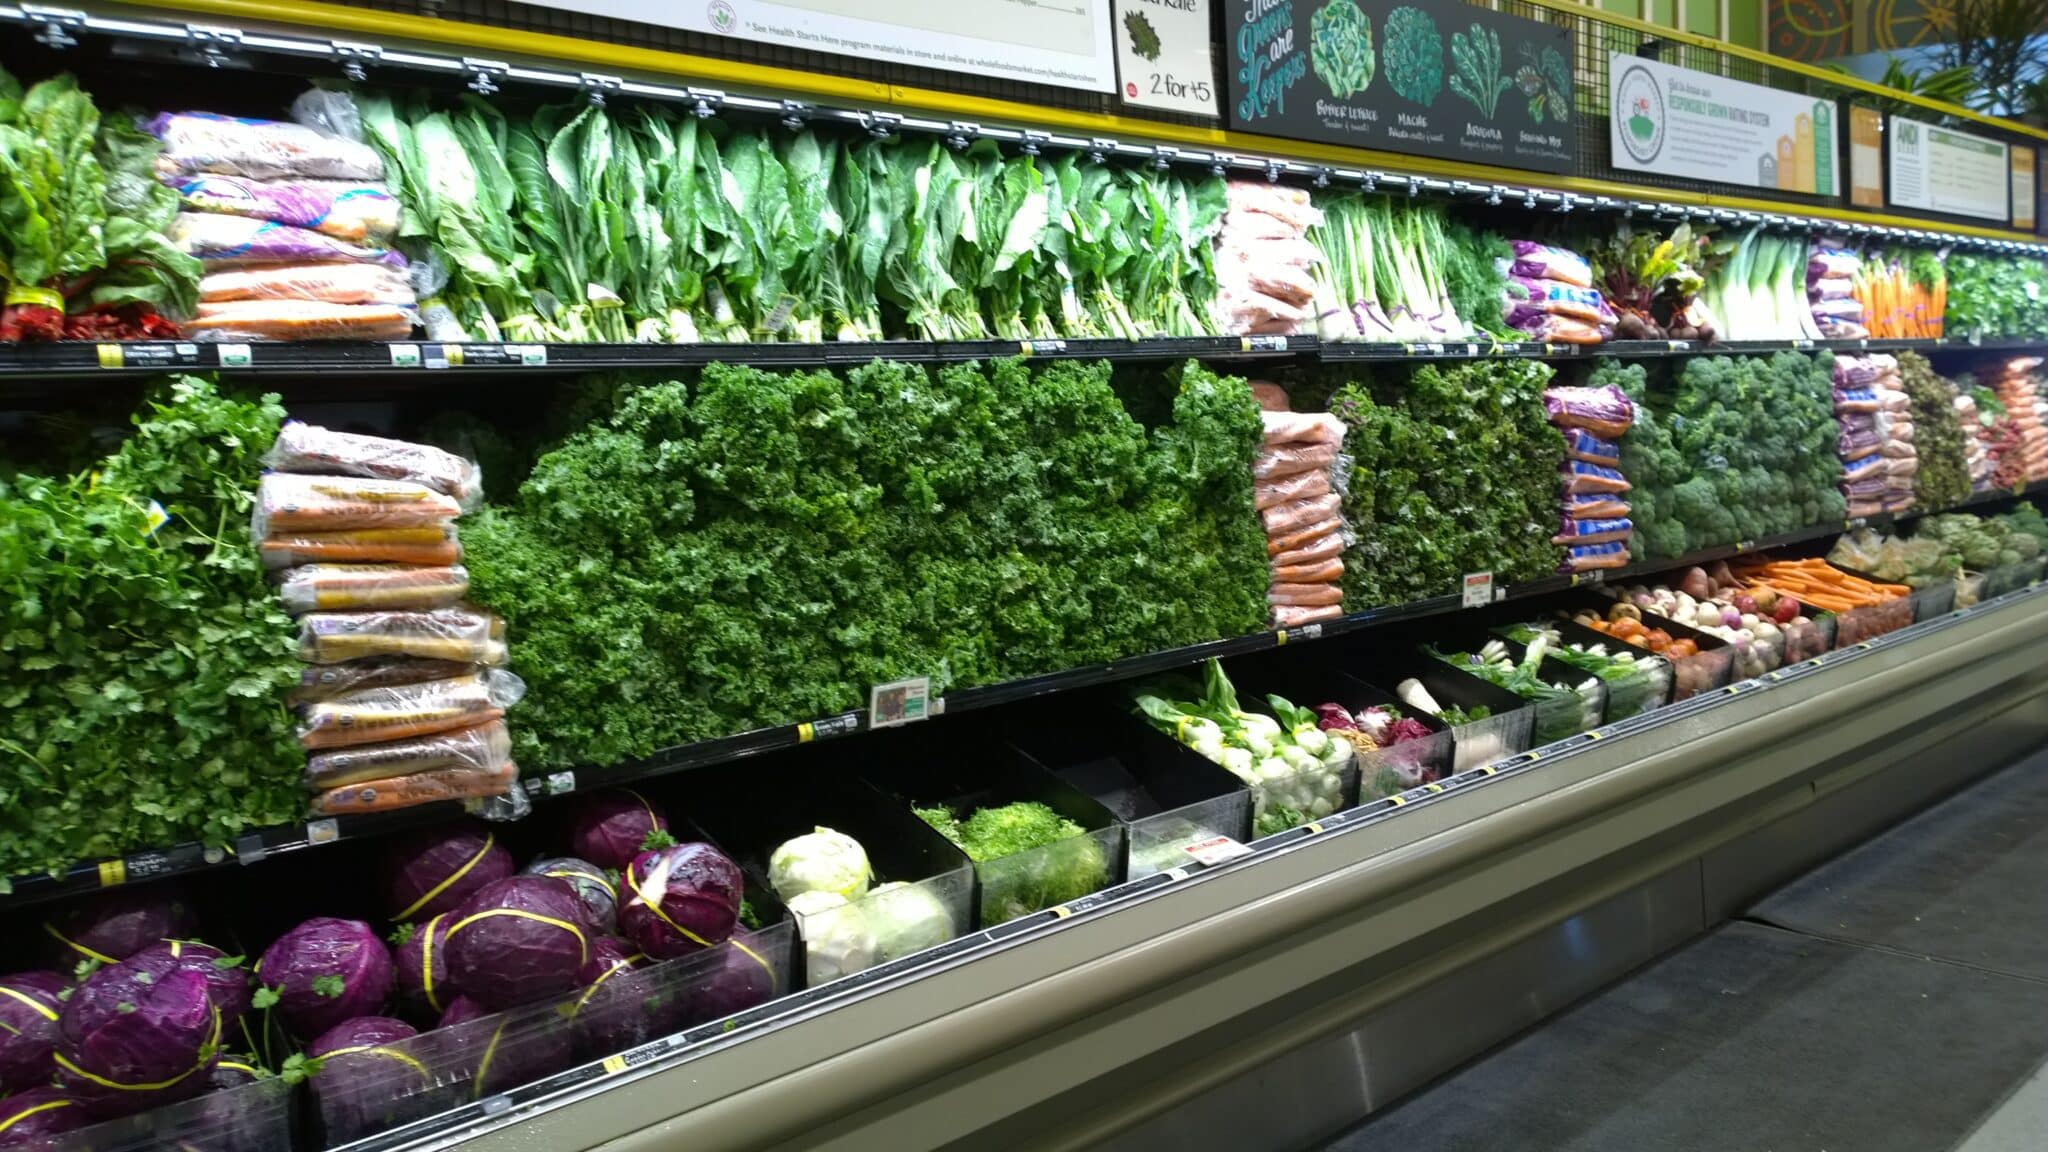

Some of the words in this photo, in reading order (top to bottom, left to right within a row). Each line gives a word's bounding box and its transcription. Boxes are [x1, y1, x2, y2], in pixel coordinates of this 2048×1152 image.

[752, 22, 767, 33] See
[768, 25, 795, 38] Health
[796, 29, 820, 42] Starts
[821, 34, 840, 46] Here
[840, 38, 872, 50] program
[873, 42, 904, 55] materials
[906, 48, 913, 57] in
[915, 50, 931, 60] store
[933, 52, 946, 62] and
[947, 54, 967, 65] online
[1270, 29, 1293, 62] are
[1150, 73, 1163, 94] 2
[1165, 74, 1188, 98] for
